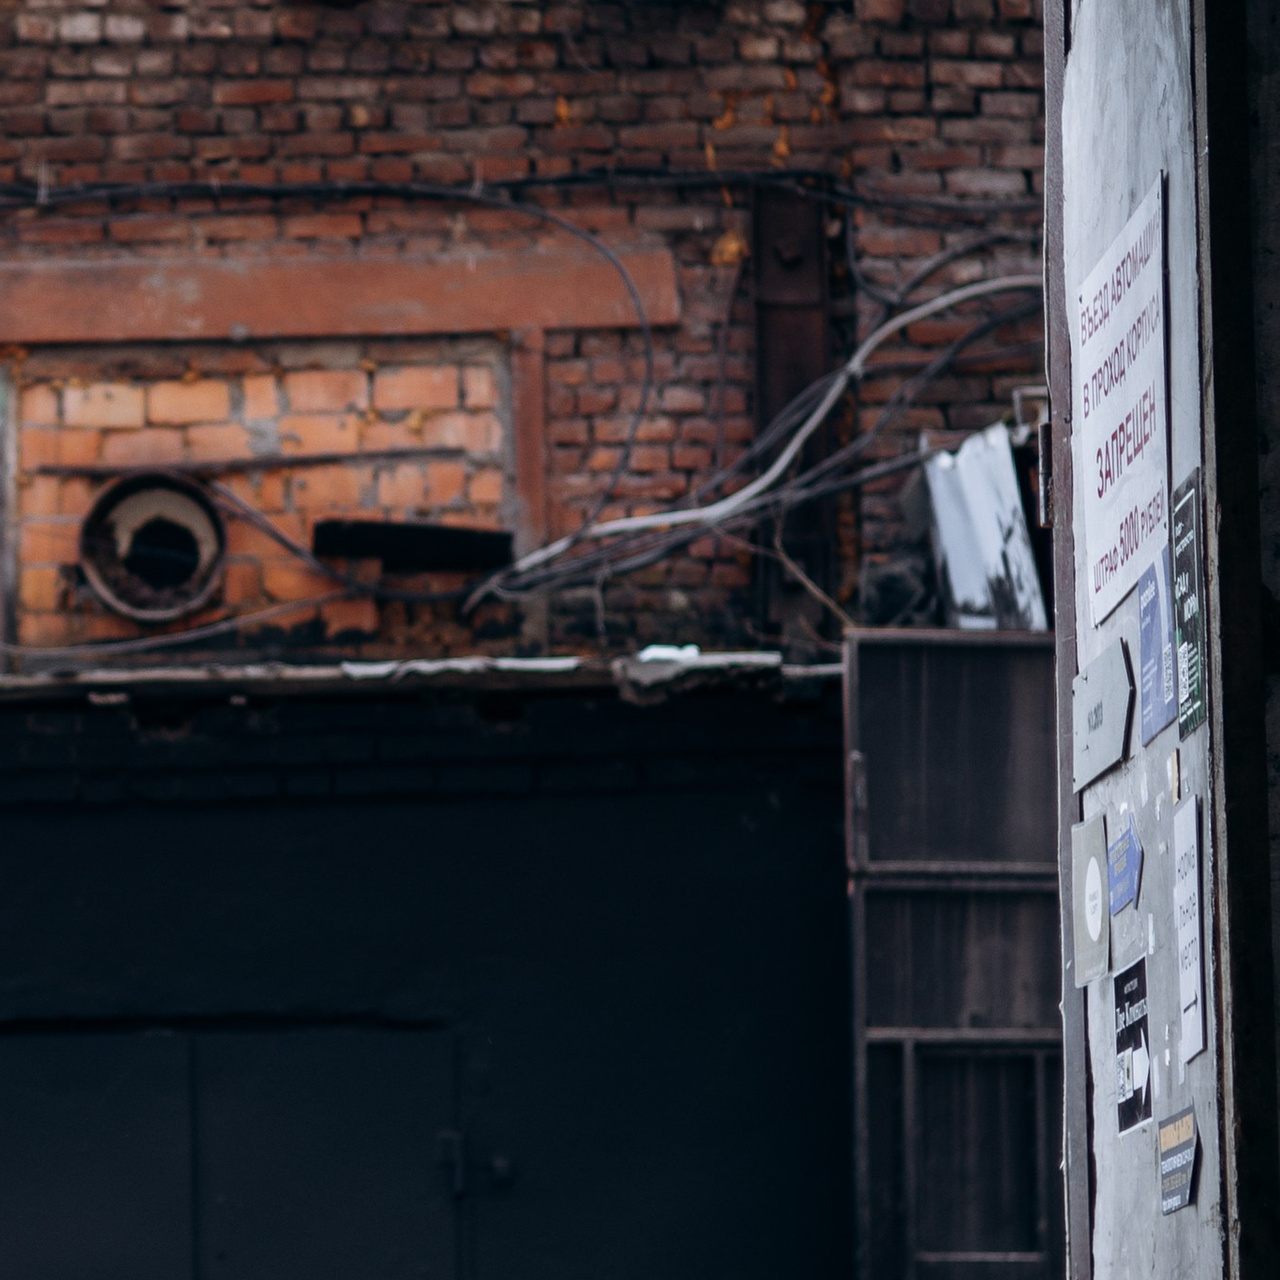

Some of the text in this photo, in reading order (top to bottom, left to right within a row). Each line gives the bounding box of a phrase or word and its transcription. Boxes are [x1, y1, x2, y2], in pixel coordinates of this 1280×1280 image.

[1081, 208, 1161, 347] ВЪЕЗД АВТОМАШИН
[1083, 288, 1161, 419] В ПРОХОД КОРПУСА
[1096, 379, 1156, 499] ЗАПРЕЩЕН
[1093, 480, 1164, 594] ШТРАФ 5000 РУБЛЕЙ
